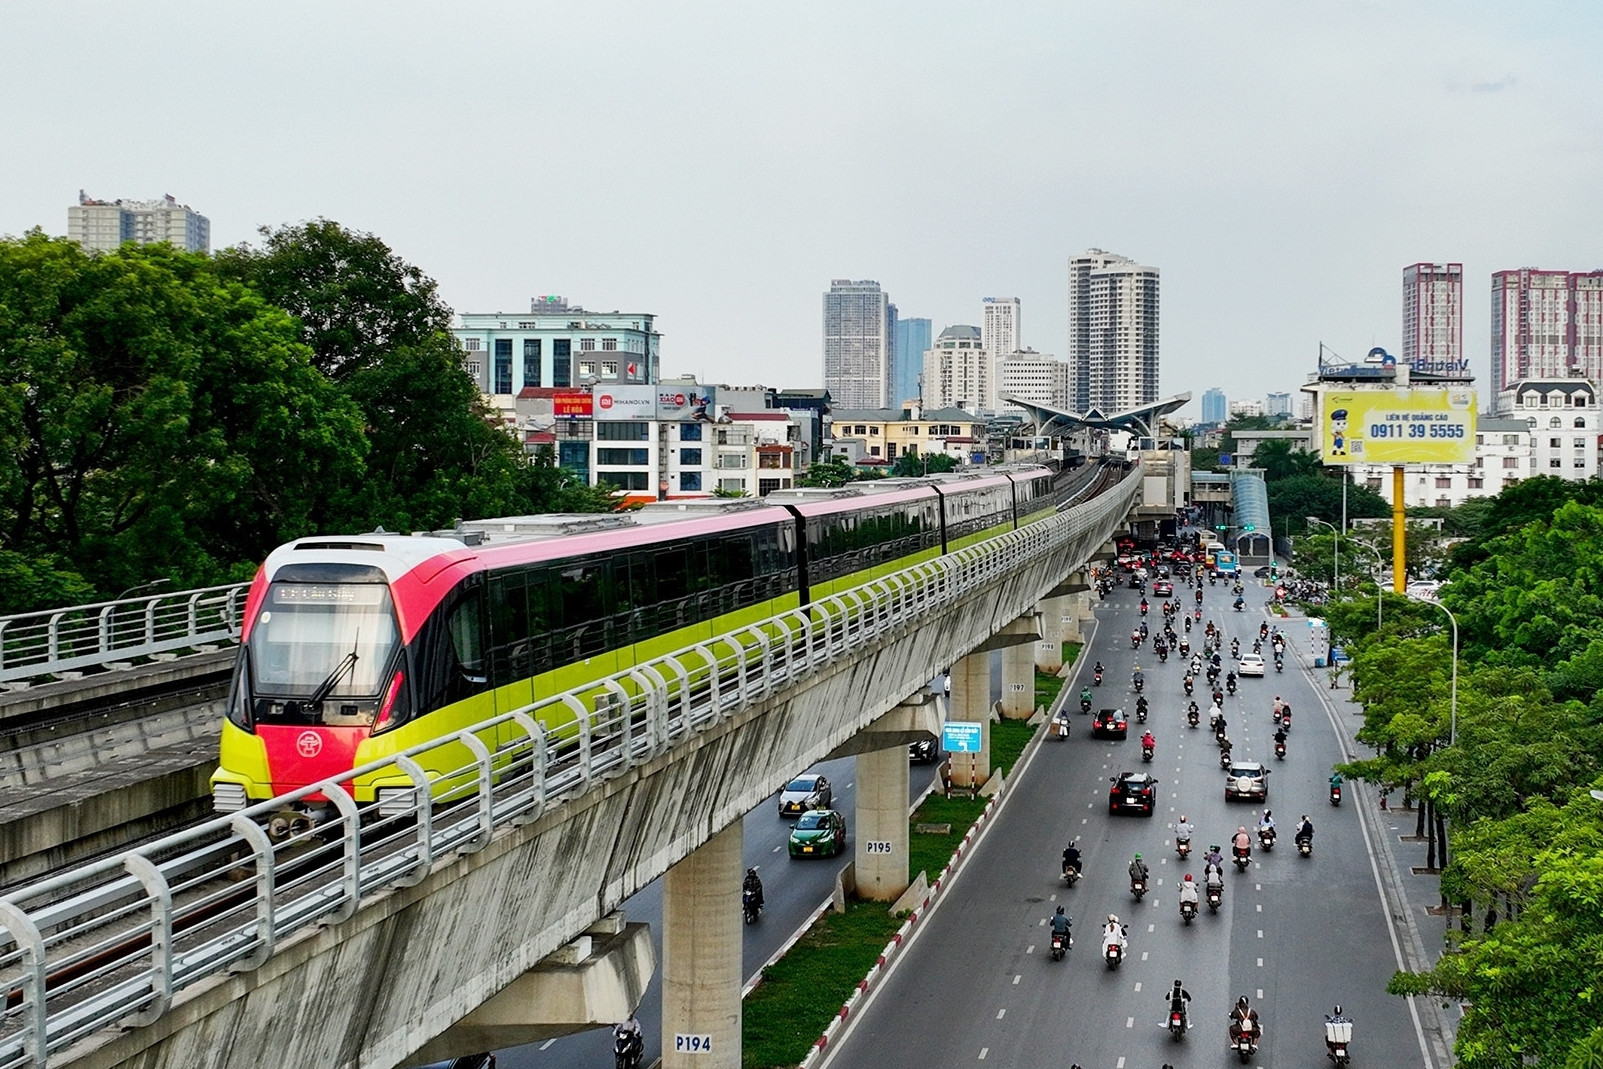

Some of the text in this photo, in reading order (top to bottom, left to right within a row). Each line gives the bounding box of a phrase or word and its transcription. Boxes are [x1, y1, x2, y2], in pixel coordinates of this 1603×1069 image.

[1371, 424, 1464, 438] 0911 39 5555
[867, 842, 891, 853] P195
[677, 1036, 710, 1051] P194
